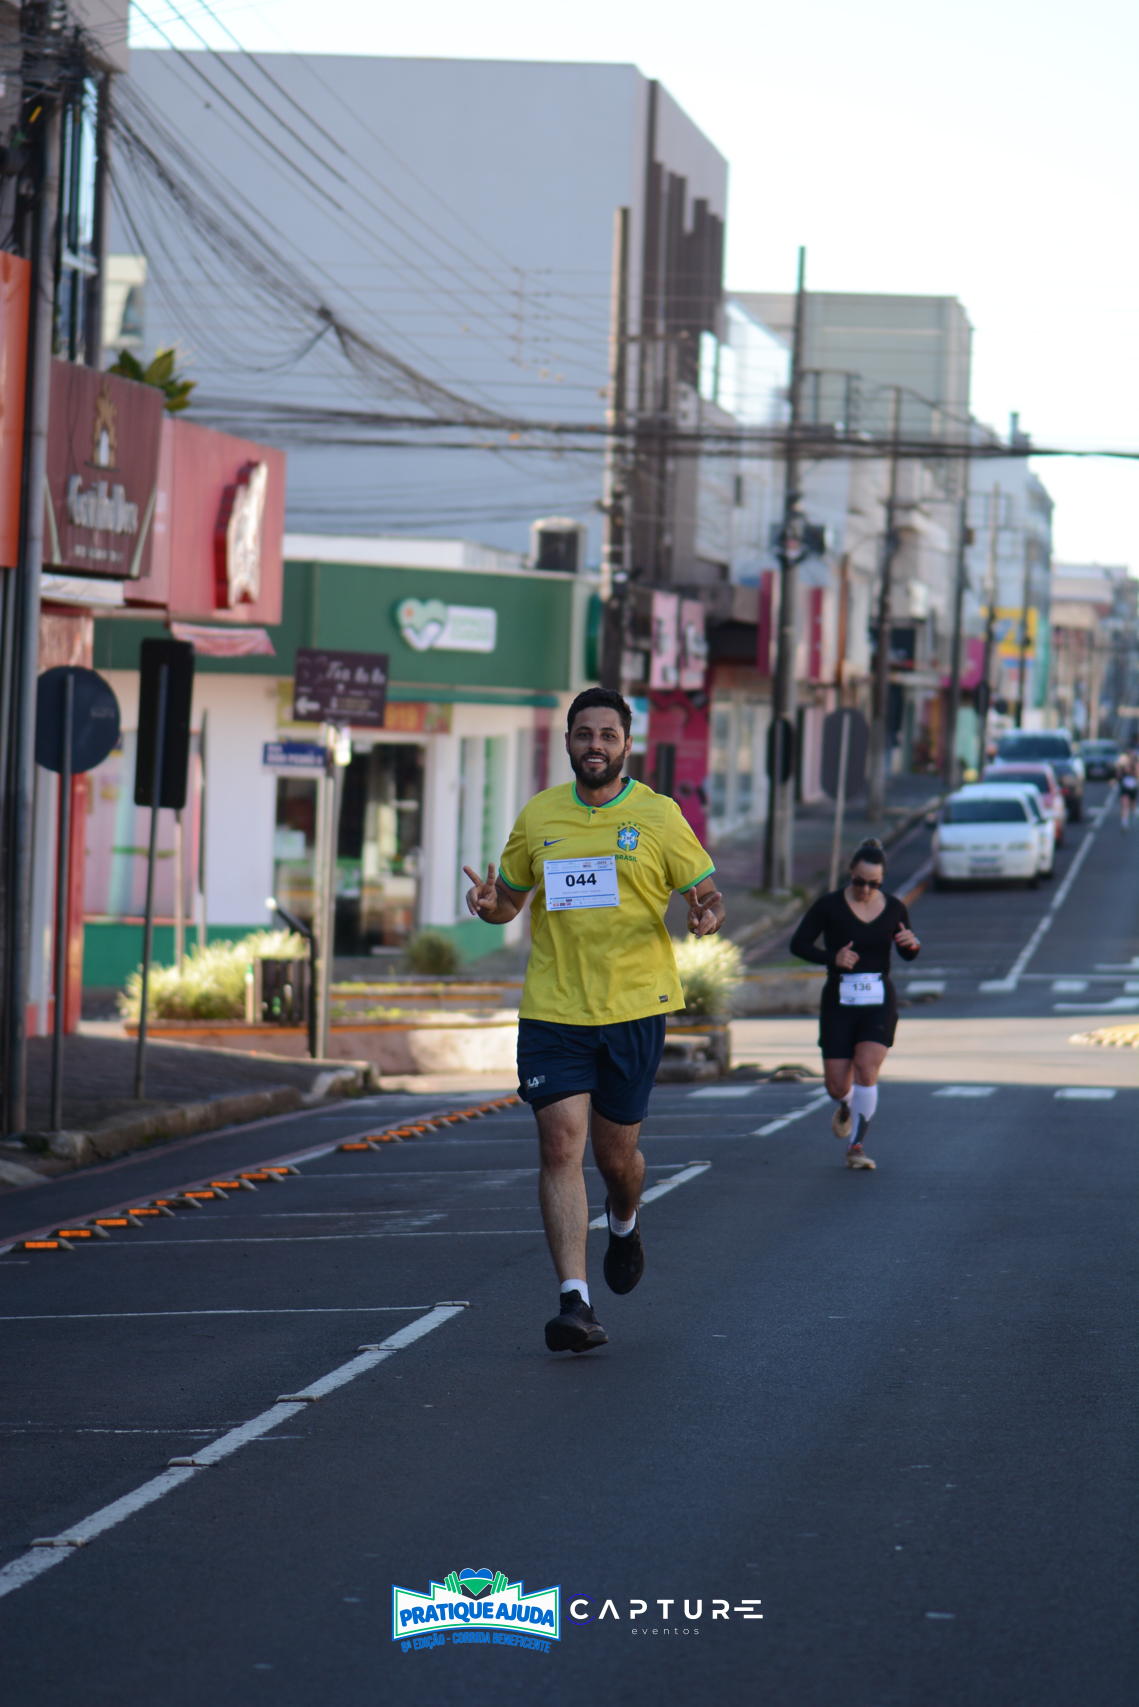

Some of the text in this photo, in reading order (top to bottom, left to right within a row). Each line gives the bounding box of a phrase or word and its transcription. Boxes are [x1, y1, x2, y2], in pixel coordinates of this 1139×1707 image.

[614, 854, 638, 862] BRASIL
[565, 873, 597, 887] 044
[853, 983, 871, 991] 136
